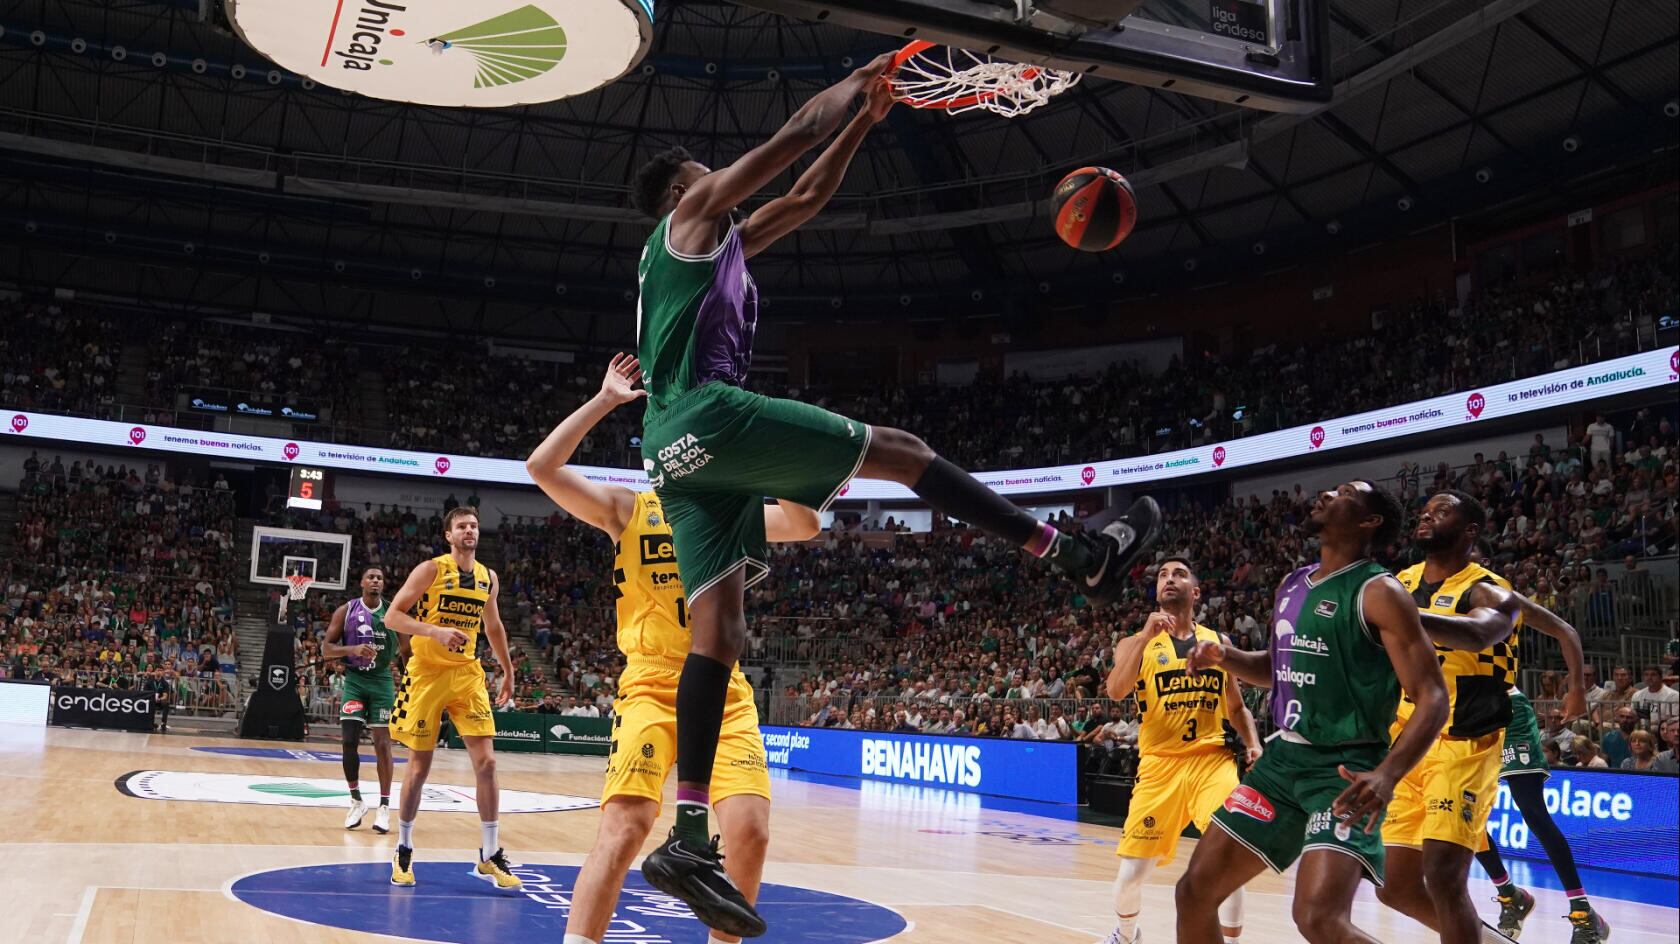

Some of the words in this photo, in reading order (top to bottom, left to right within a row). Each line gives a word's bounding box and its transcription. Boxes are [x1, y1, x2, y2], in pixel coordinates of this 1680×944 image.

[1212, 7, 1236, 22] liga
[1213, 21, 1265, 42] endesa
[1508, 394, 1518, 402] la
[1520, 383, 1567, 399] televisión
[1570, 380, 1584, 390] de
[1587, 366, 1646, 386] Andalucía.
[1468, 398, 1484, 410] 101
[13, 419, 27, 427] 101
[1342, 423, 1375, 435] tenemos
[1377, 416, 1407, 428] buenas
[1409, 408, 1444, 421] noticias.
[131, 431, 145, 439] 101
[164, 435, 198, 445] tenemos
[200, 439, 229, 448] buenas
[231, 442, 263, 451] noticias.
[1312, 431, 1324, 441] 101
[286, 446, 298, 454] 101
[658, 433, 698, 461] COSTA
[1214, 451, 1225, 459] 101
[328, 450, 364, 460] televisión
[378, 455, 420, 466] Andalucía.
[663, 459, 683, 473] DEL
[681, 445, 706, 463] SOL
[1121, 463, 1153, 474] televisión
[1165, 457, 1200, 468] Andalucía.
[300, 469, 323, 480] 3:43
[608, 475, 636, 483] buenas
[1034, 475, 1063, 483] noticias.
[1083, 470, 1094, 478] 101
[300, 482, 313, 499] 5
[440, 597, 482, 615] Lenov
[1290, 633, 1329, 653] Unicaja
[1158, 674, 1219, 692] Lenovo
[57, 693, 150, 714] endesa
[1283, 699, 1302, 730] 6
[1182, 718, 1198, 742] 3
[765, 731, 790, 746] second
[790, 731, 810, 751] place
[769, 748, 790, 764] world
[861, 739, 982, 787] BENAHAVIS
